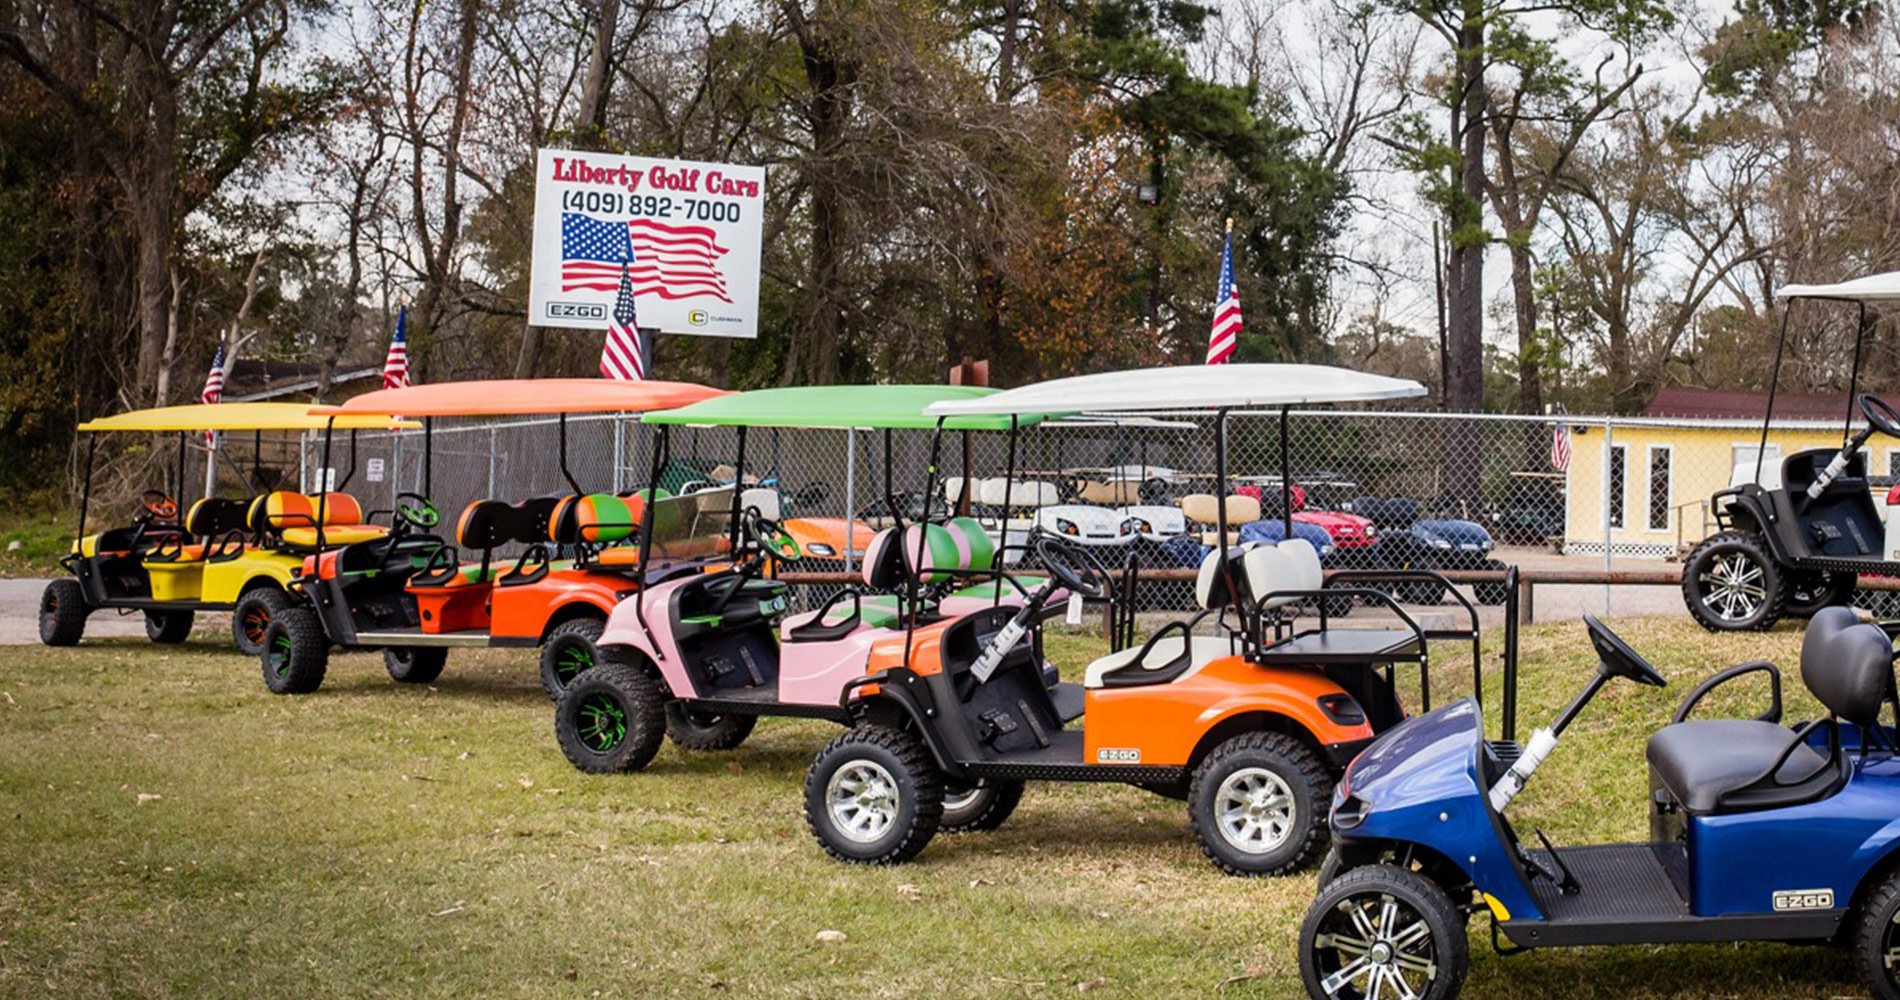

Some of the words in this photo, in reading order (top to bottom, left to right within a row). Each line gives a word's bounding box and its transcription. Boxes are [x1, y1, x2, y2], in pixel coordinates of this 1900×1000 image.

[553, 157, 644, 193] Liberty
[649, 165, 701, 192] Golf
[705, 171, 759, 198] Cars
[563, 190, 624, 214] (409)
[629, 195, 740, 223] 892-7000
[551, 305, 602, 317] EZGO
